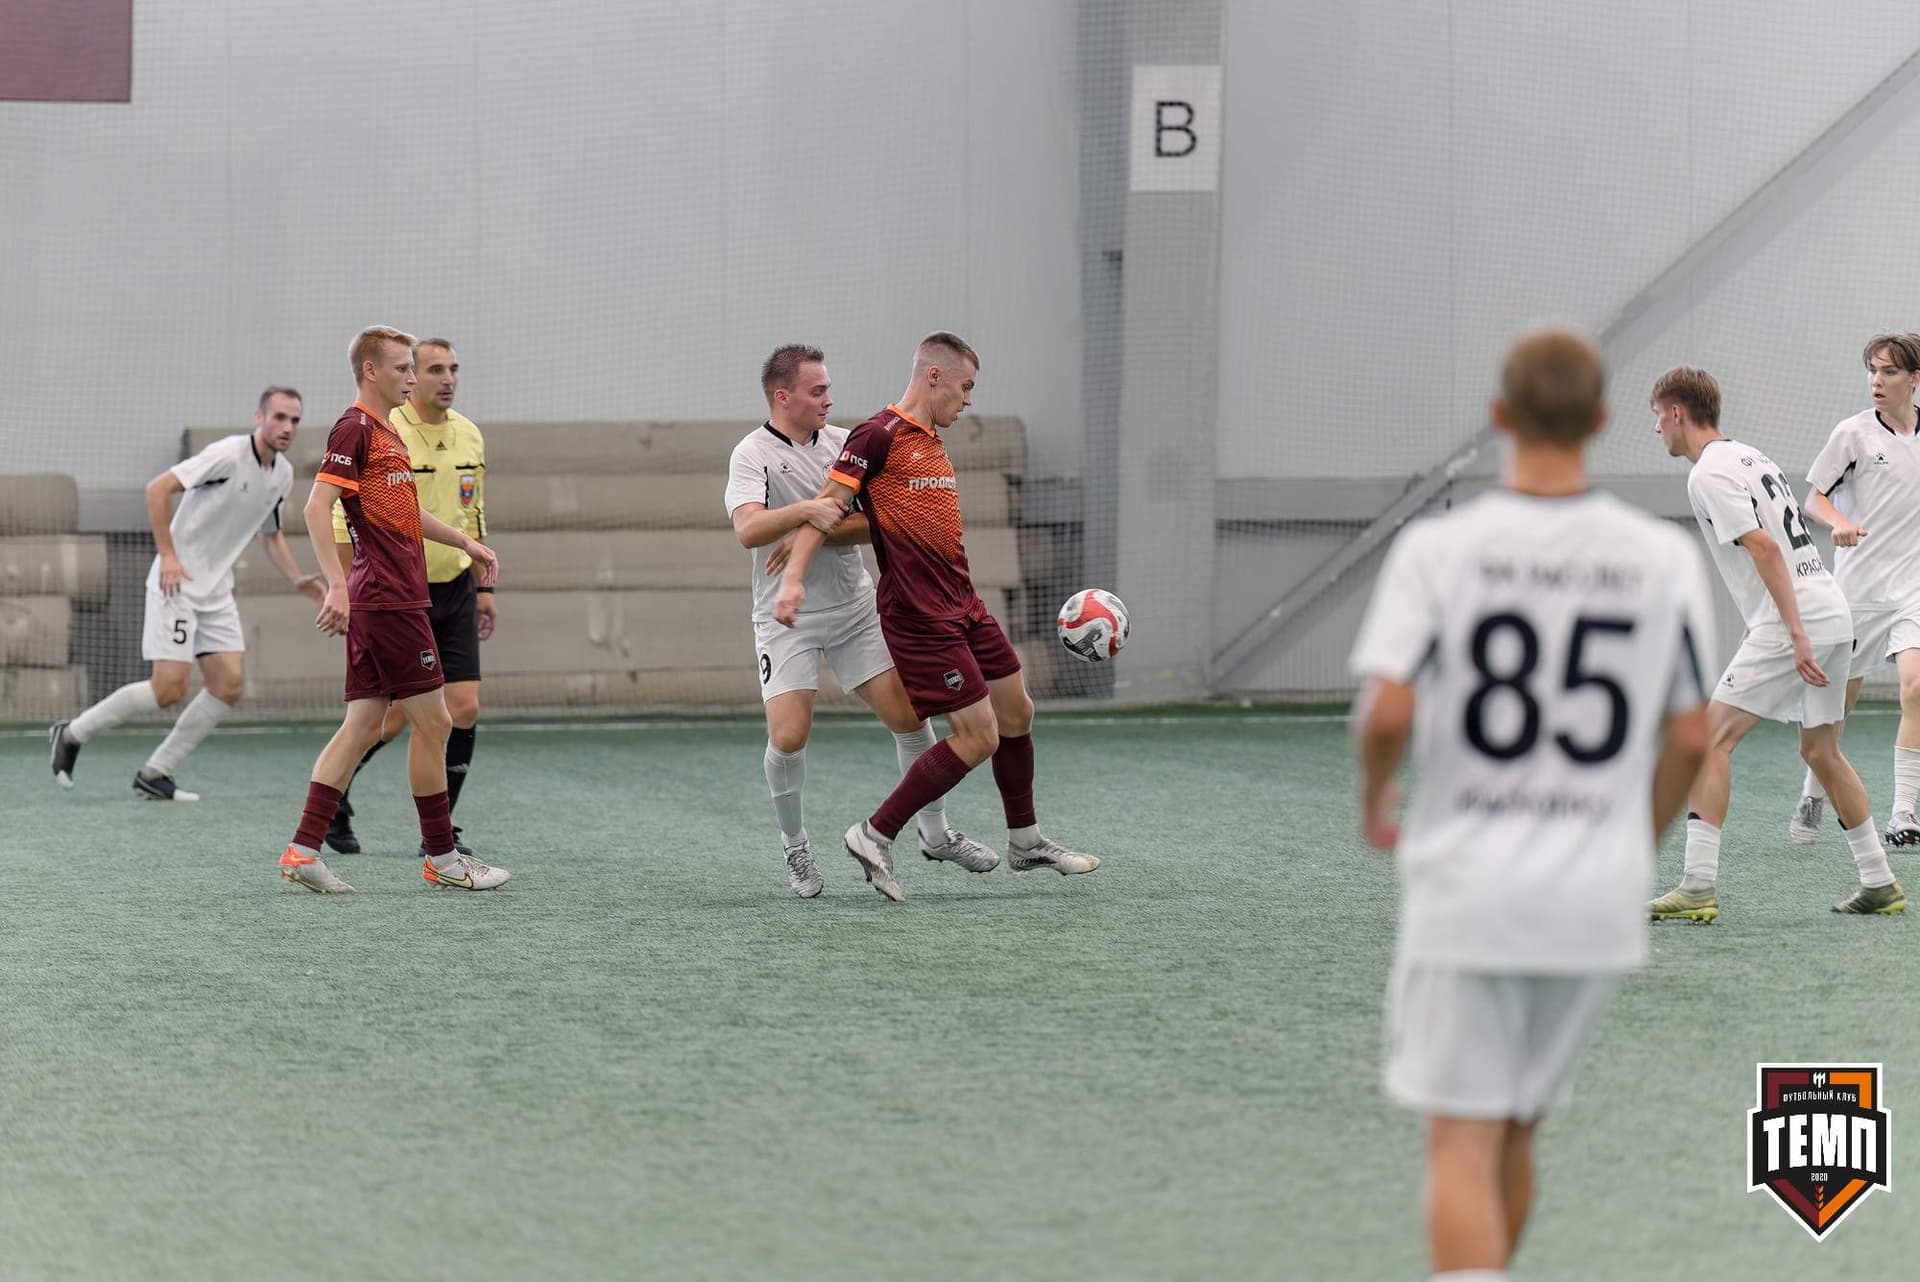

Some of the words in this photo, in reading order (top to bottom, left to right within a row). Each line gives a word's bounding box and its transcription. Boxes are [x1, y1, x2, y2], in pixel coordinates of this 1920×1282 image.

[330, 453, 352, 466] ПСБ
[173, 620, 187, 644] 5
[760, 653, 771, 685] 9
[1464, 610, 1636, 767] 85
